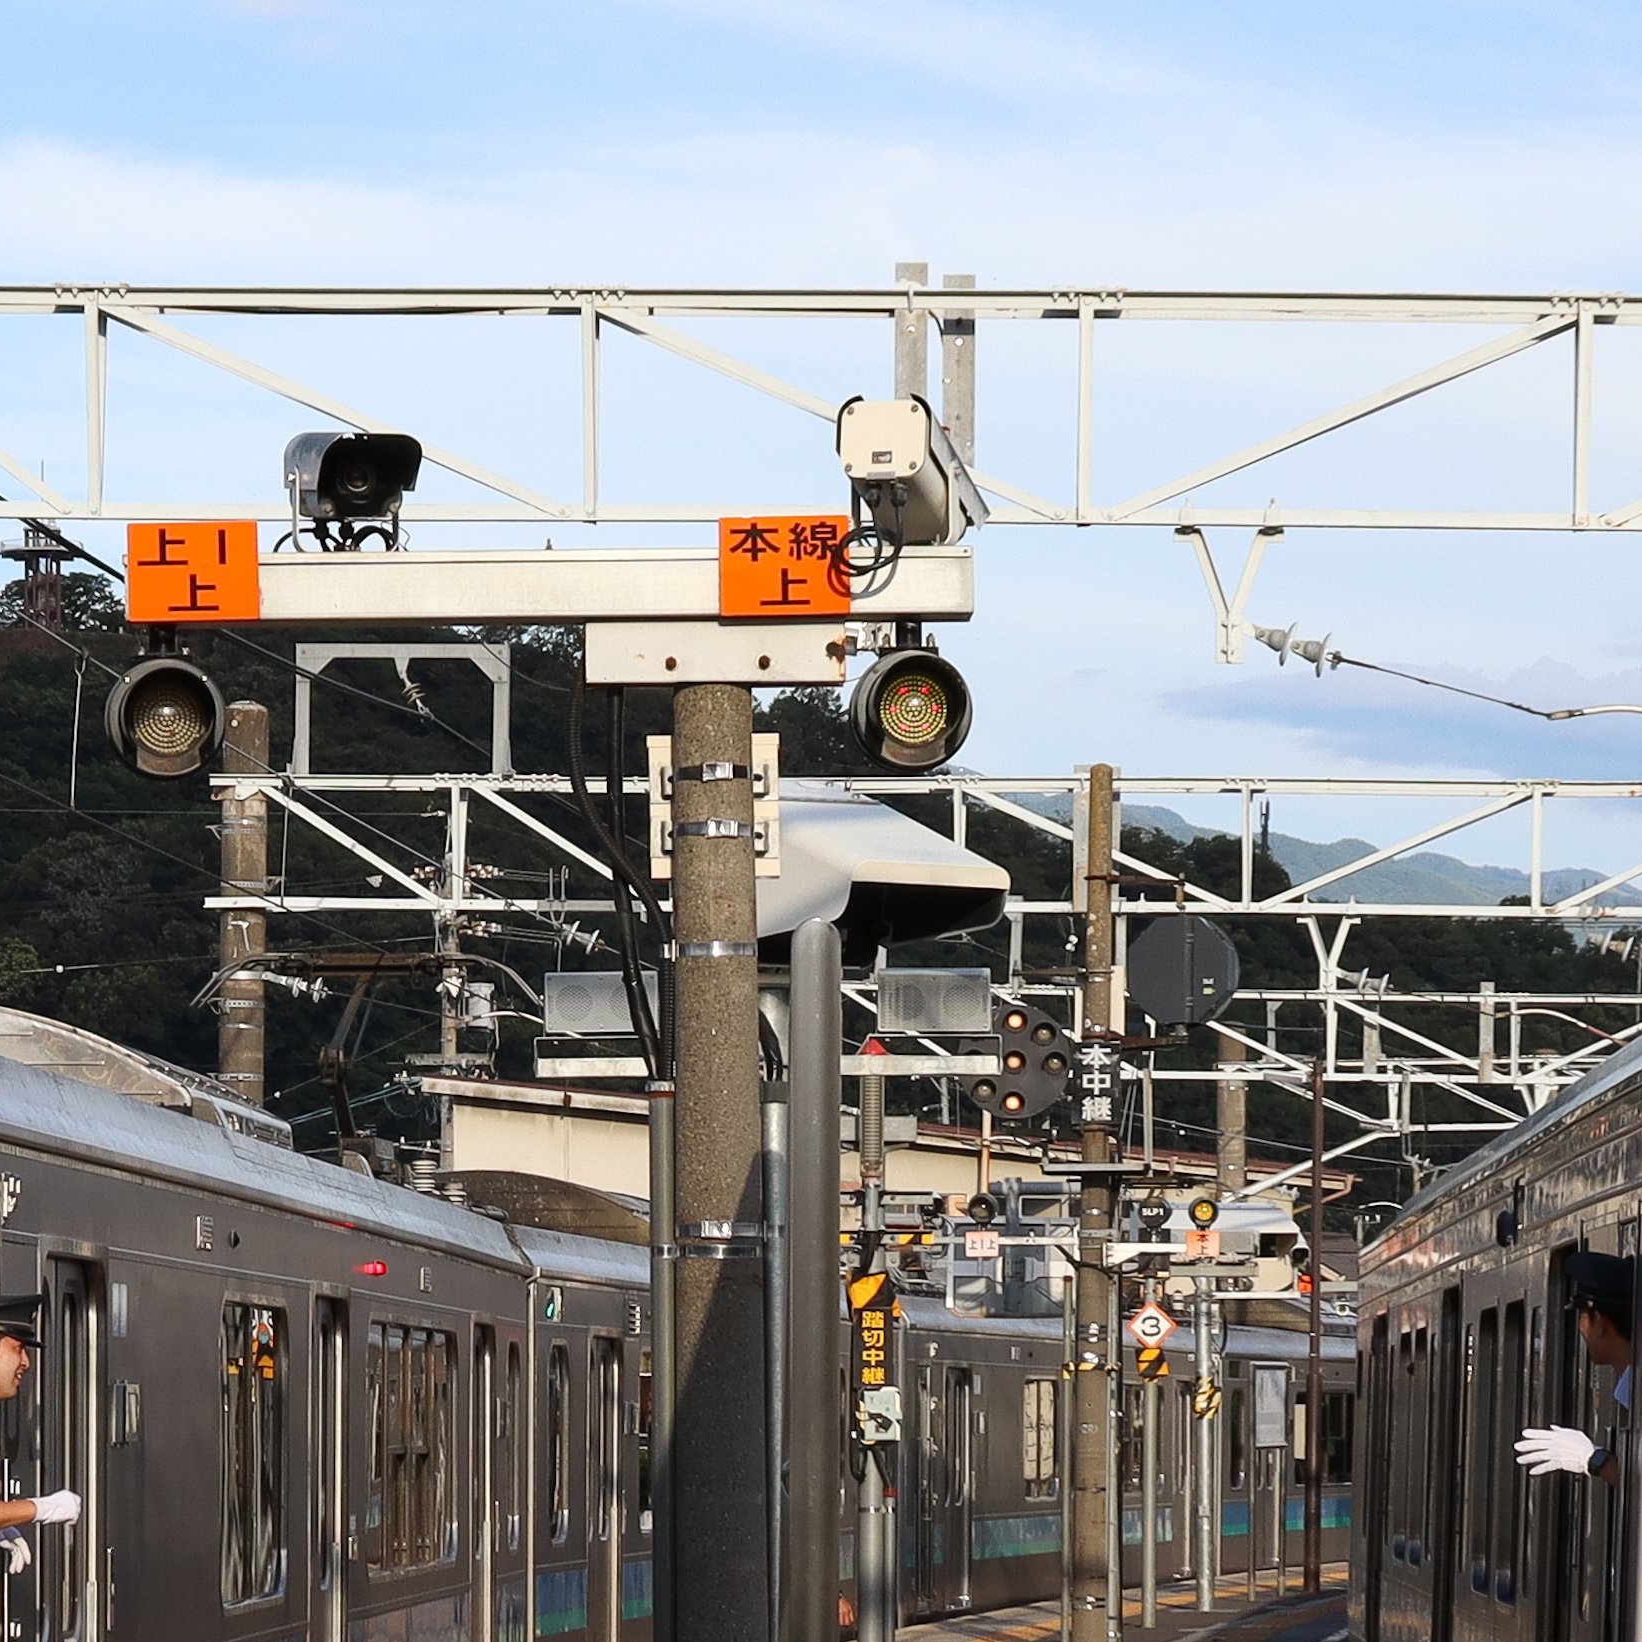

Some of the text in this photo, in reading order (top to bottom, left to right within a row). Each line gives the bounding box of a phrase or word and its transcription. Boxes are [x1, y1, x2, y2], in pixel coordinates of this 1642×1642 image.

[729, 522, 839, 561] 本線
[168, 574, 219, 611] 上
[760, 568, 811, 606] 上
[1081, 1044, 1112, 1121] 本中継
[1140, 1314, 1161, 1338] 3
[861, 1310, 885, 1385] 踏切中継
